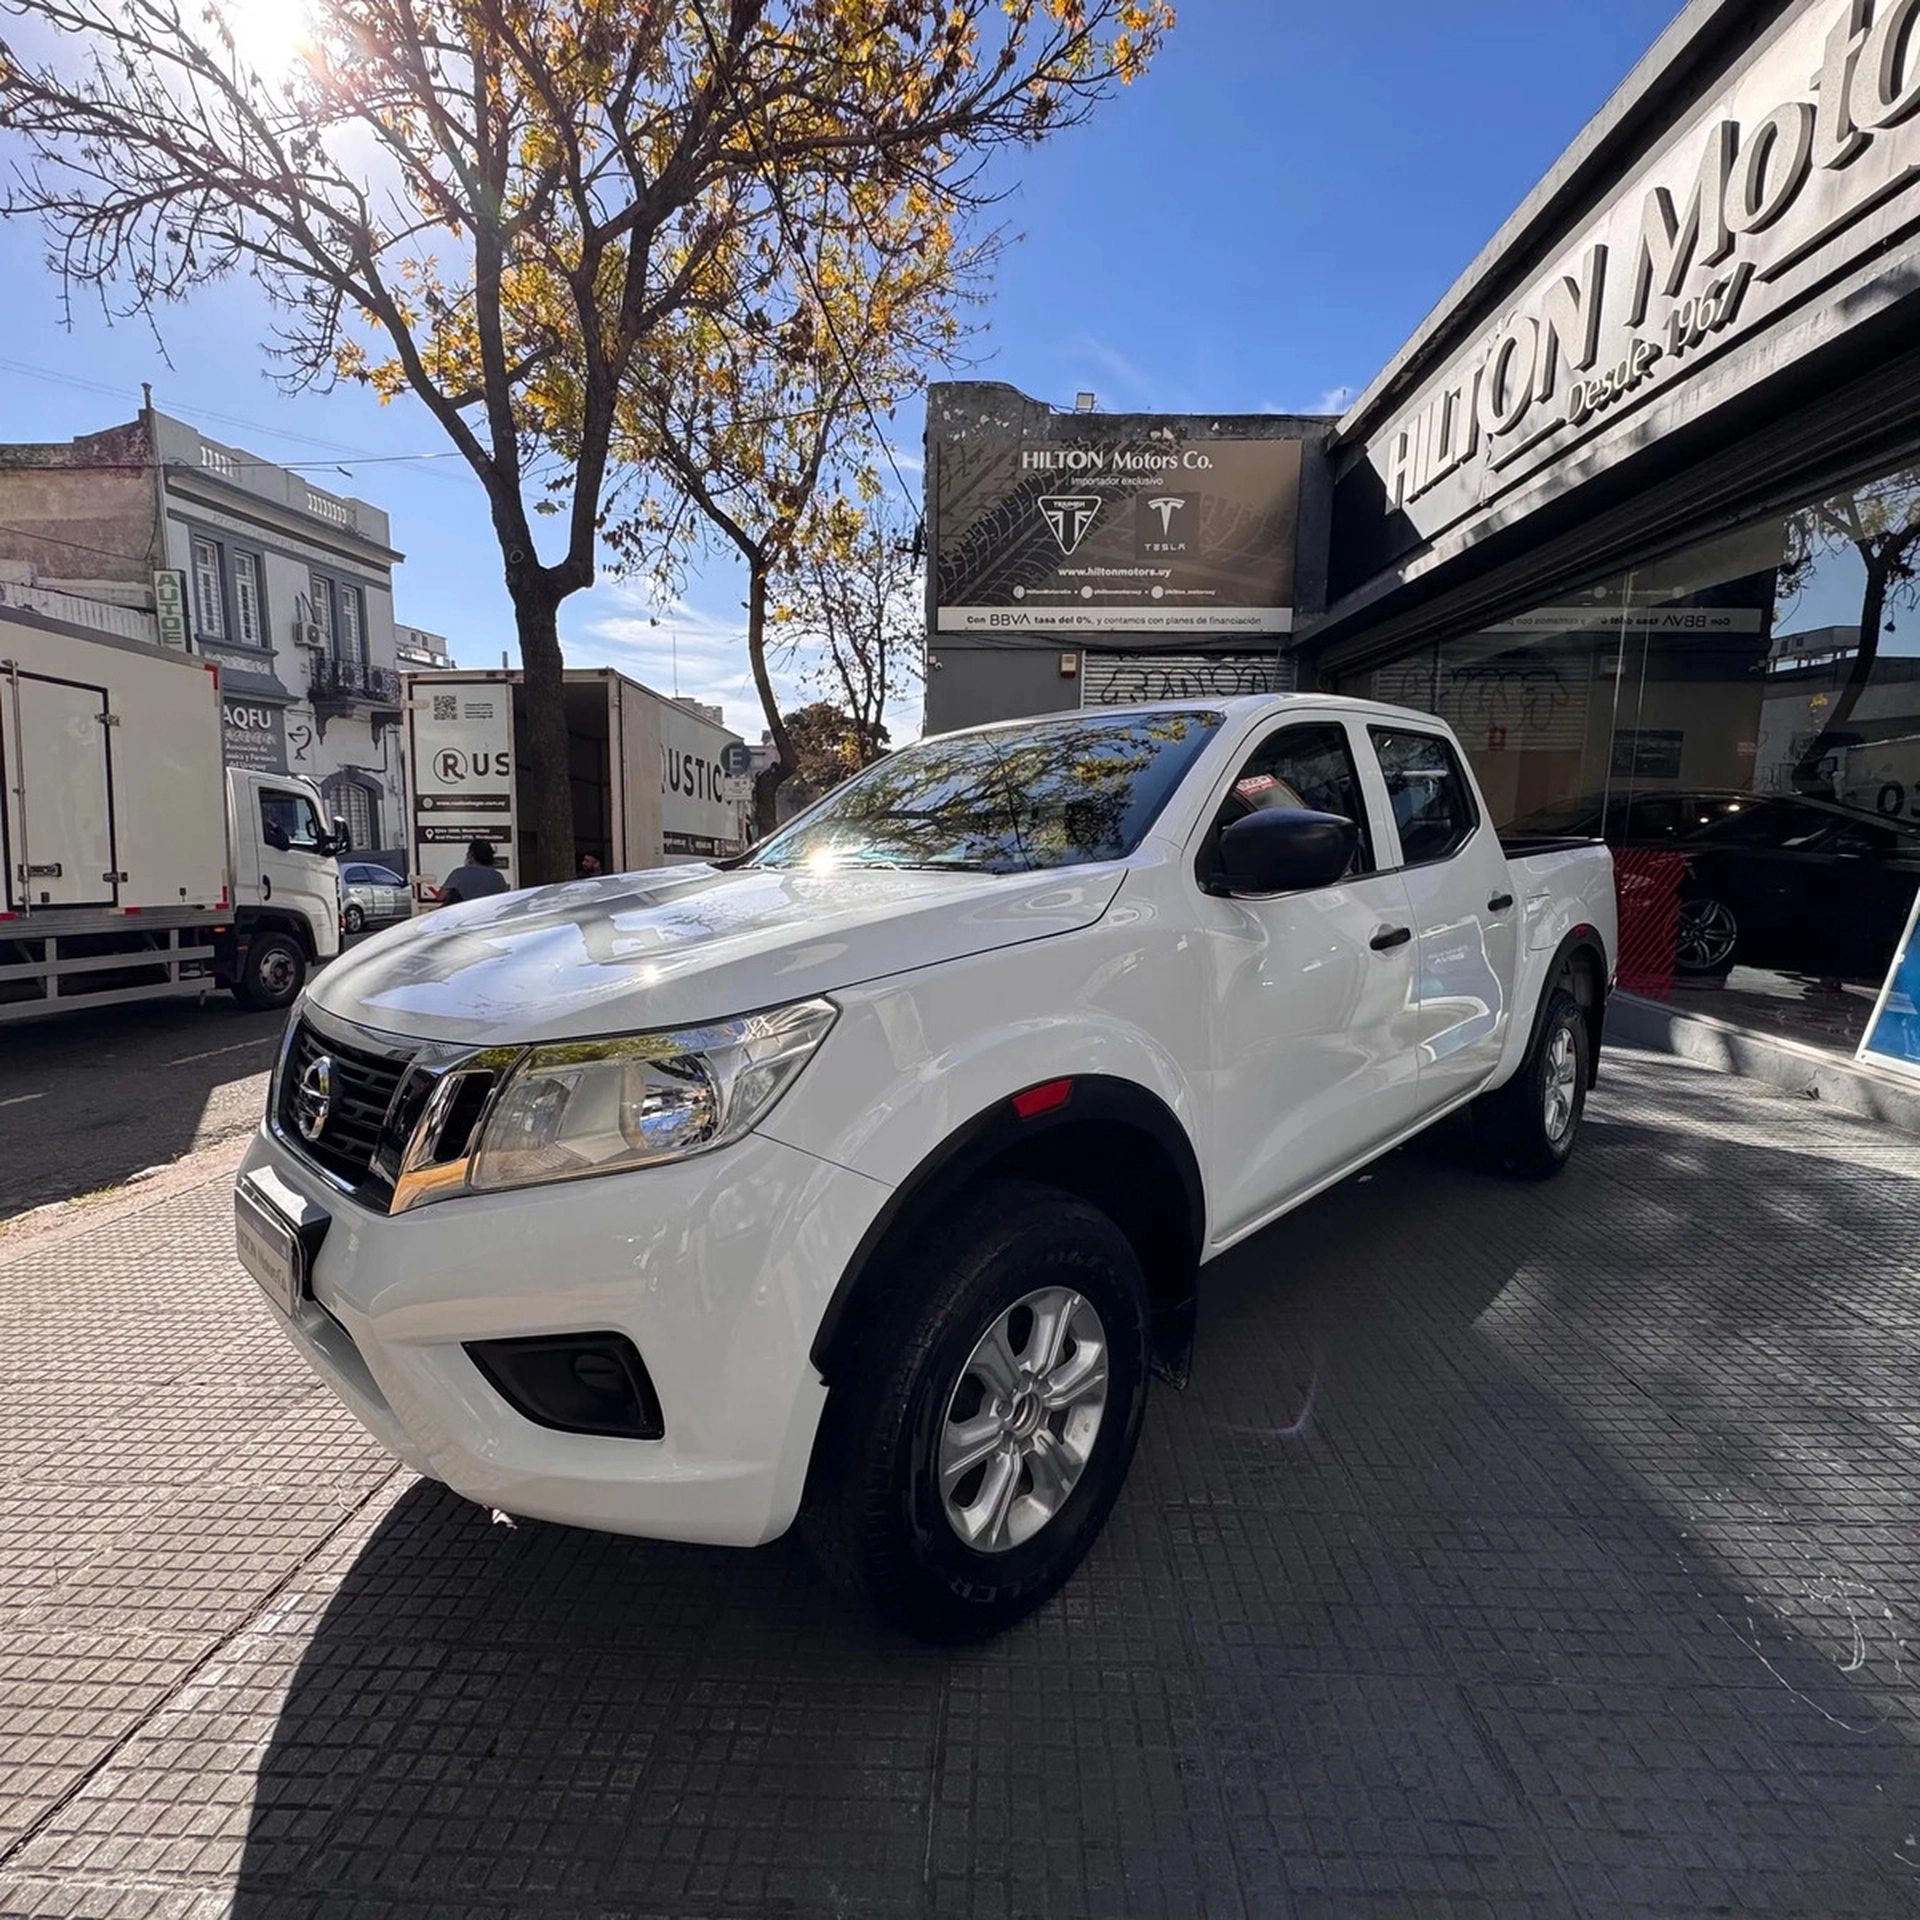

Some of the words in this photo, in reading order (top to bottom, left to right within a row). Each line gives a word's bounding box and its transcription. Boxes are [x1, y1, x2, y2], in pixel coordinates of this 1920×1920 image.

[1568, 338, 1662, 427] Desde
[1663, 261, 1757, 358] 1967
[1387, 244, 1608, 506] HILTON
[1022, 450, 1104, 469] HILTON
[1112, 452, 1178, 469] Motors
[1183, 450, 1213, 469] Co.
[1071, 476, 1119, 487] Importador
[1121, 476, 1163, 486] exclusivo
[1144, 543, 1186, 551] TESLA
[1058, 567, 1171, 578] www.hiltonmotors.uy
[967, 615, 986, 625] Con
[990, 613, 1031, 627] BBVA
[1034, 616, 1057, 625] tasa
[1058, 615, 1074, 625] del
[1096, 617, 1102, 627] y
[1104, 616, 1146, 626] contamos
[1147, 617, 1164, 626] con
[1166, 616, 1194, 627] planes
[1196, 616, 1207, 626] de
[1209, 615, 1262, 626] financiación
[224, 705, 272, 730] AQFU
[661, 744, 731, 805] USTIC
